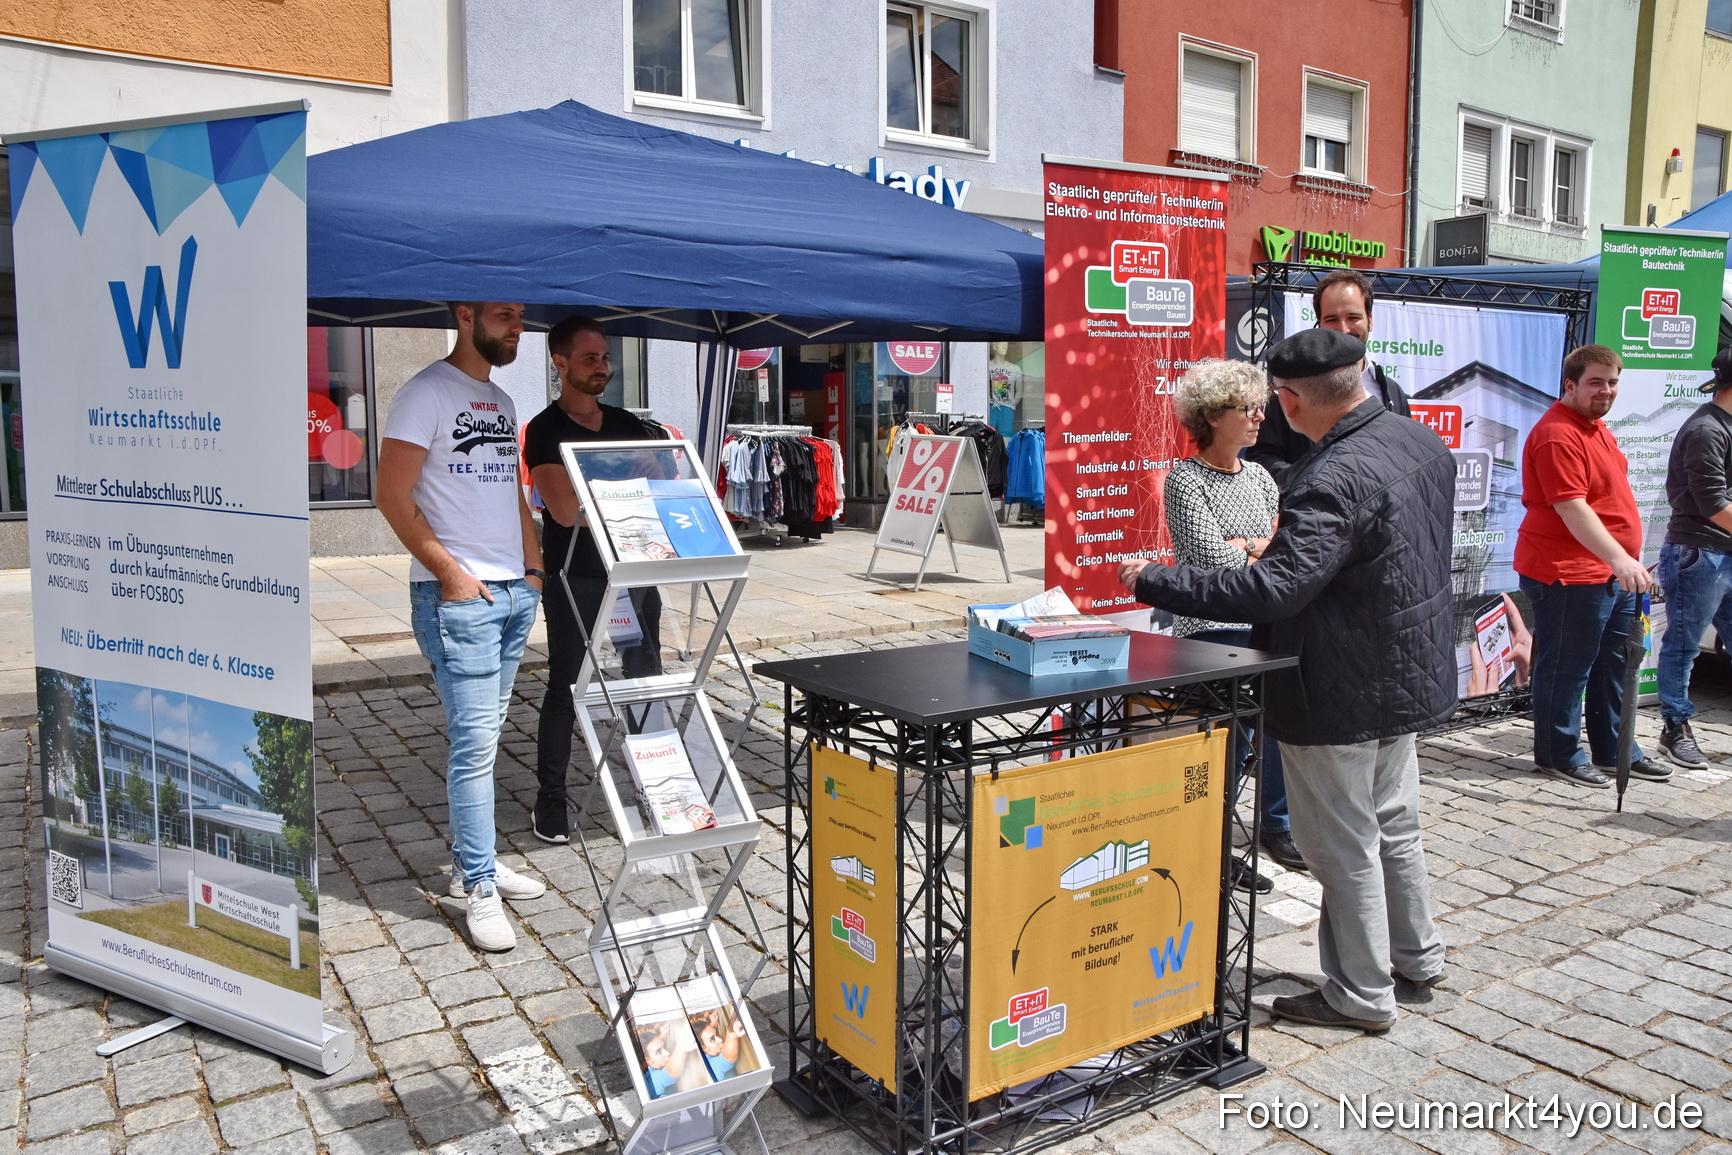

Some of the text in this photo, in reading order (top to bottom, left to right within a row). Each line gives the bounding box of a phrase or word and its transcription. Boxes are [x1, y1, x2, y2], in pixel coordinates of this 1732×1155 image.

[1048, 182, 1224, 211] Staatlich geprüfte/r Techniker/in
[1046, 202, 1226, 230] Elektro- und Informationstechnik
[1122, 249, 1161, 266] ET+IT
[1603, 242, 1724, 260] Staatlich geprüfte/r Techniker/in
[1118, 265, 1161, 276] Smart Energy
[1642, 259, 1685, 271] Bautechnik
[1146, 286, 1186, 302] BauTe
[1649, 294, 1675, 306] ET+IT
[1131, 301, 1186, 312] Energiesparendes
[1166, 311, 1186, 319] Bauen
[1087, 318, 1118, 327] Staatliche
[1662, 320, 1691, 332] BauTe
[1087, 329, 1138, 338] Technikerschule
[1139, 330, 1169, 339] Neumarkt
[895, 344, 935, 359] SALE
[1155, 359, 1171, 369] Wir
[1679, 373, 1697, 381] bauen
[128, 386, 184, 401] Staatliche
[469, 401, 499, 412] VINTAGE
[828, 385, 839, 443] ALE
[88, 406, 221, 432] Wirtschaftsschule
[1411, 411, 1456, 431] T+IT
[89, 433, 161, 448] Neumarkt
[1063, 431, 1132, 445] Themenfelder:
[1636, 450, 1661, 459] Bestand
[1076, 461, 1119, 475] Industrie
[1120, 460, 1136, 472] 4.0
[1143, 458, 1171, 471] Smart
[1456, 459, 1482, 479] uTe
[57, 474, 97, 496] Mittlerer
[100, 478, 191, 503] Schulabschluss
[600, 489, 645, 499] Zukunft
[1076, 484, 1128, 499] Smart Grid
[1459, 492, 1481, 501] Bauen
[895, 494, 937, 515] SALE
[1076, 507, 1135, 522] Smart Home
[46, 530, 101, 549] PRAXIS-LERNEN
[1076, 529, 1124, 545] Informatik
[108, 533, 234, 565] im Übungsunternehmen
[1076, 555, 1103, 567] Cisco
[1105, 547, 1158, 564] Networking
[47, 552, 90, 571] VORSPRUNG
[48, 574, 89, 594] ANSCHLUSS
[110, 558, 300, 604] durch kaufmännische Grundbildung
[111, 582, 184, 605] über FOSBOS
[1091, 598, 1113, 609] Keine
[61, 627, 275, 681] NEU: Übertritt nach der 6. Klasse
[635, 747, 678, 760] Zukunft
[1039, 789, 1075, 803] Staatliches
[1039, 780, 1181, 820] Berufliches Schulzentrum
[1046, 817, 1077, 831] Neumarkt
[1071, 805, 1180, 836] www.BeruflichesSchulzentrum.com
[217, 890, 280, 920] Mittelschule West
[1090, 892, 1123, 907] NEUMARKT
[218, 901, 281, 932] Wirtschaftsschule
[1090, 921, 1119, 938] STARK
[856, 934, 873, 951] BauTe
[1071, 932, 1135, 959] mit beruflicher
[101, 937, 242, 996] www.BeruflichesSchulzentrum.com
[1084, 952, 1122, 972] Bildung!
[1015, 993, 1044, 1010] ET+IT
[1132, 981, 1201, 1008] Wirtschaftsschule
[1013, 1003, 1044, 1016] Smart Energy
[1033, 1010, 1061, 1028] BauTe
[1046, 1026, 1061, 1034] Bauen
